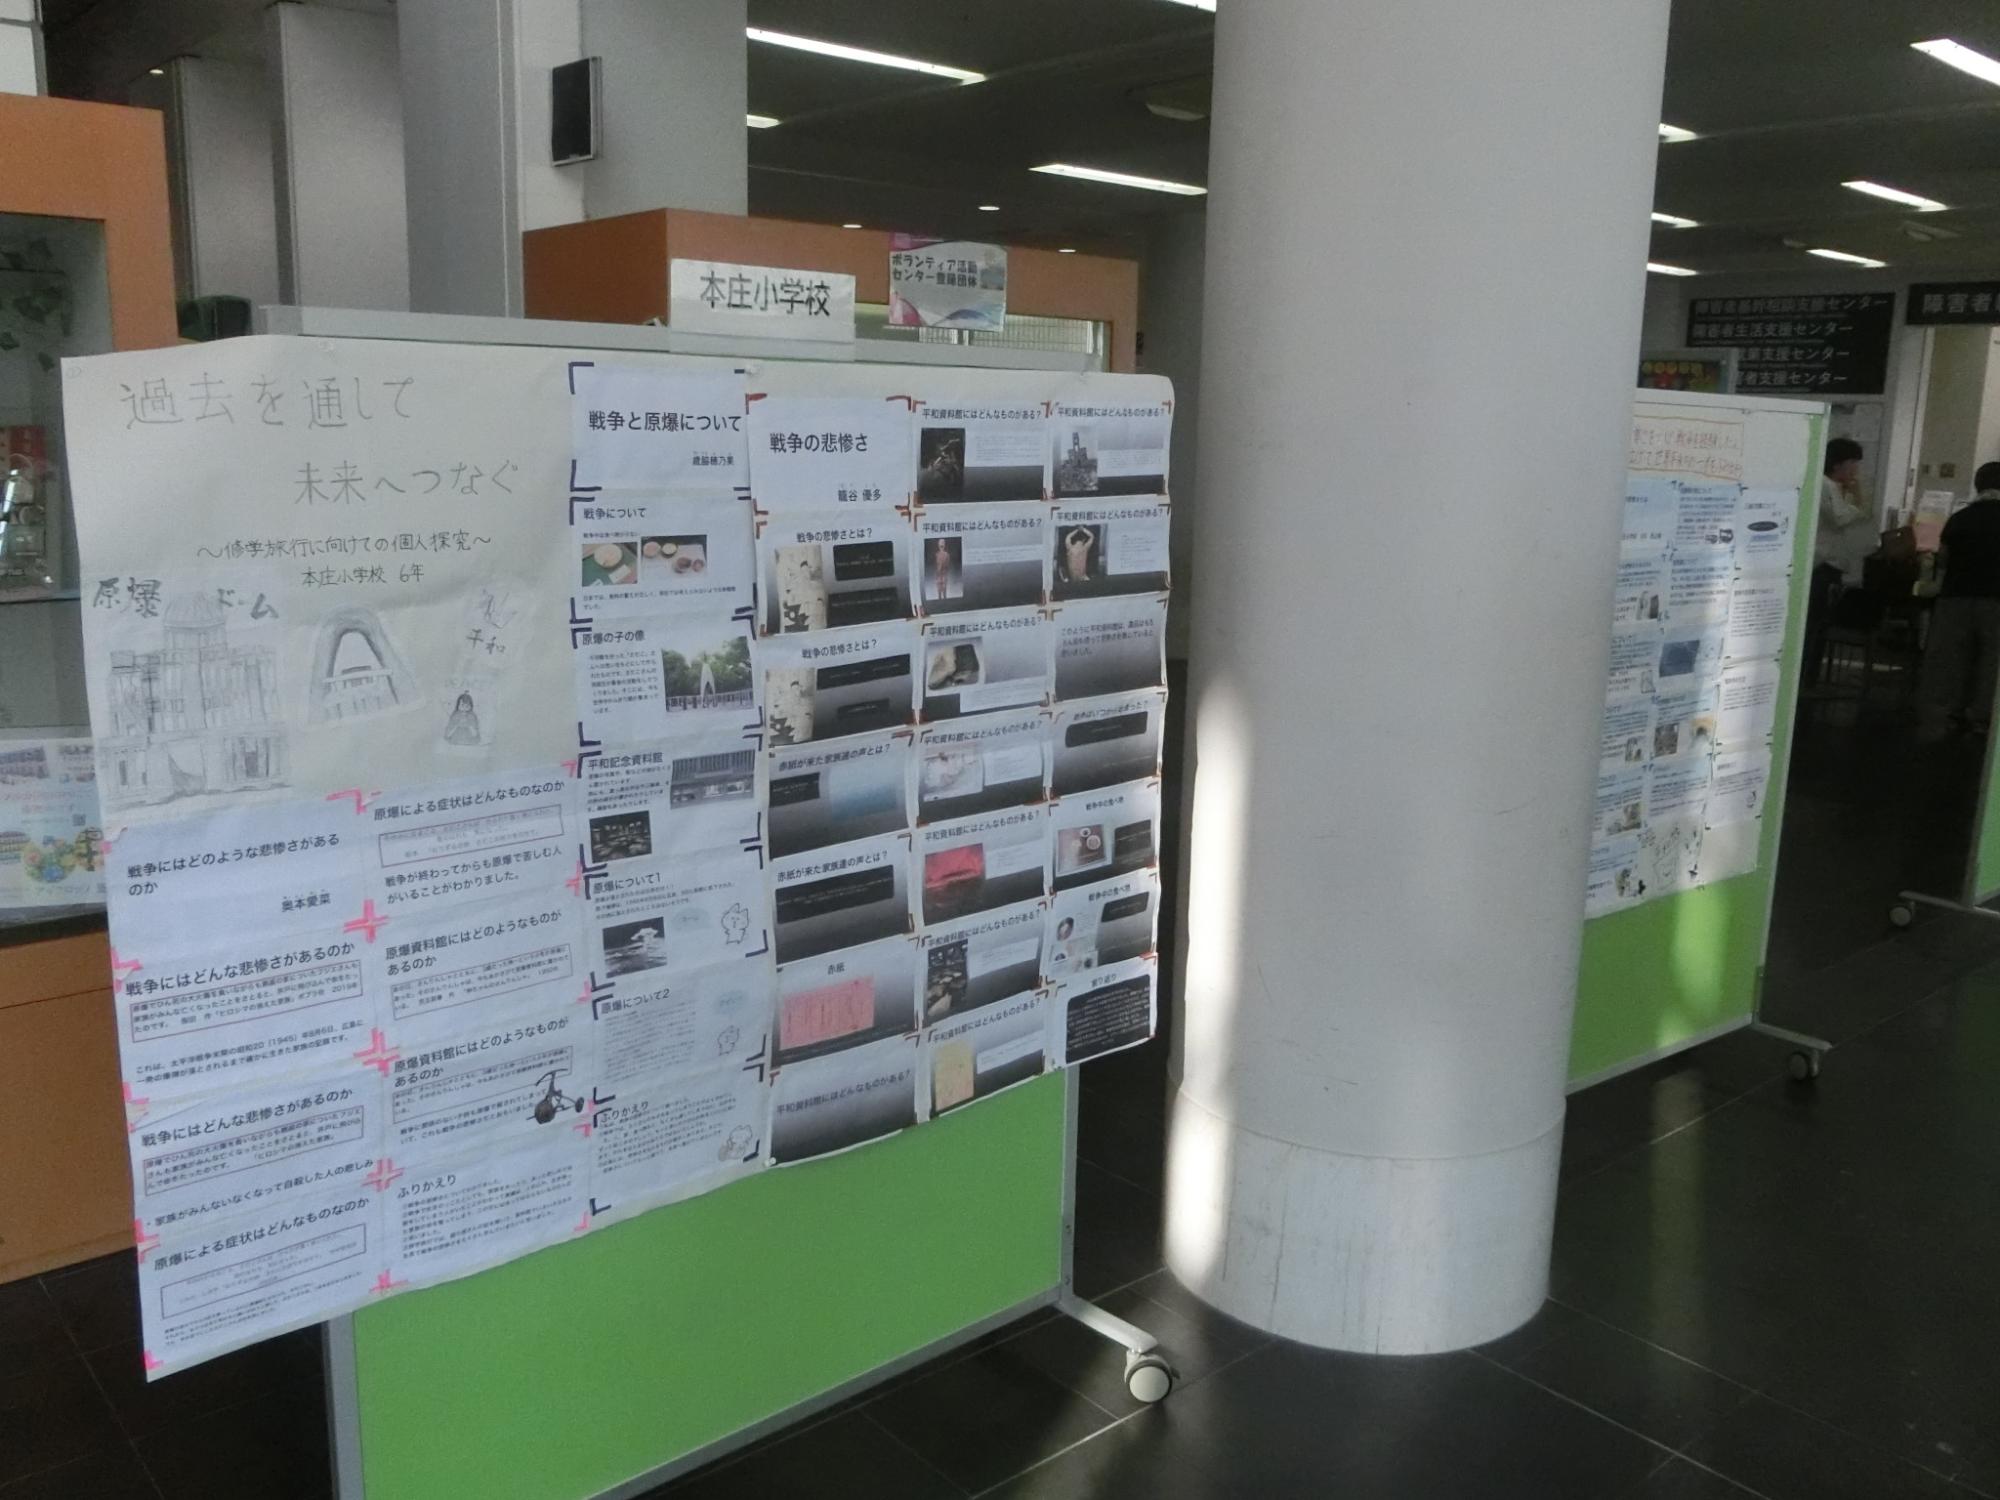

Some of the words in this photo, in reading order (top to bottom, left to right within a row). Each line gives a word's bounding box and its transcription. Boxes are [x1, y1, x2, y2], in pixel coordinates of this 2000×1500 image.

[700, 271, 831, 317] 本庄小学校
[1922, 292, 2000, 315] 障害者
[121, 373, 414, 430] 過去を通して
[588, 410, 742, 432] 戦争と原爆について
[769, 432, 868, 454] 戦争の悲惨さ
[294, 459, 519, 505] 未来へつなぐ
[583, 507, 647, 521] 戦争について
[796, 527, 873, 544] 戦争の悲惨さとは？
[302, 566, 387, 588] 本庄小学校
[400, 563, 424, 583] 6年
[93, 577, 162, 618] 原爆
[582, 630, 646, 647] 原爆の子の像
[801, 639, 878, 659] 戦争の悲惨さとは？
[587, 752, 664, 770] 平和記念資料館
[373, 780, 566, 822] 原爆による症状はどんなものなのか
[126, 832, 341, 879] 戦争にはどのような悲惨さがある
[384, 846, 563, 888] 戦争が終わってからも原爆で苦しむ人
[128, 881, 159, 897] のか
[386, 870, 520, 905] がいることがわかりました。
[386, 909, 562, 960] 原爆資料館にはどのようなものが
[125, 941, 356, 997] 戦争にはどんな悲惨さがあるのか
[387, 956, 438, 977] あるのか
[393, 1016, 570, 1073] 原爆資料館にはどのようなものが
[394, 1067, 445, 1088] あるのか
[141, 1088, 353, 1148] 戦争にはどんな悲惨さがあるのか
[600, 1101, 649, 1123] ふりかえり
[398, 1174, 457, 1200] ふりかえり
[153, 1198, 370, 1272] 原爆による症状はどんなものなのか
